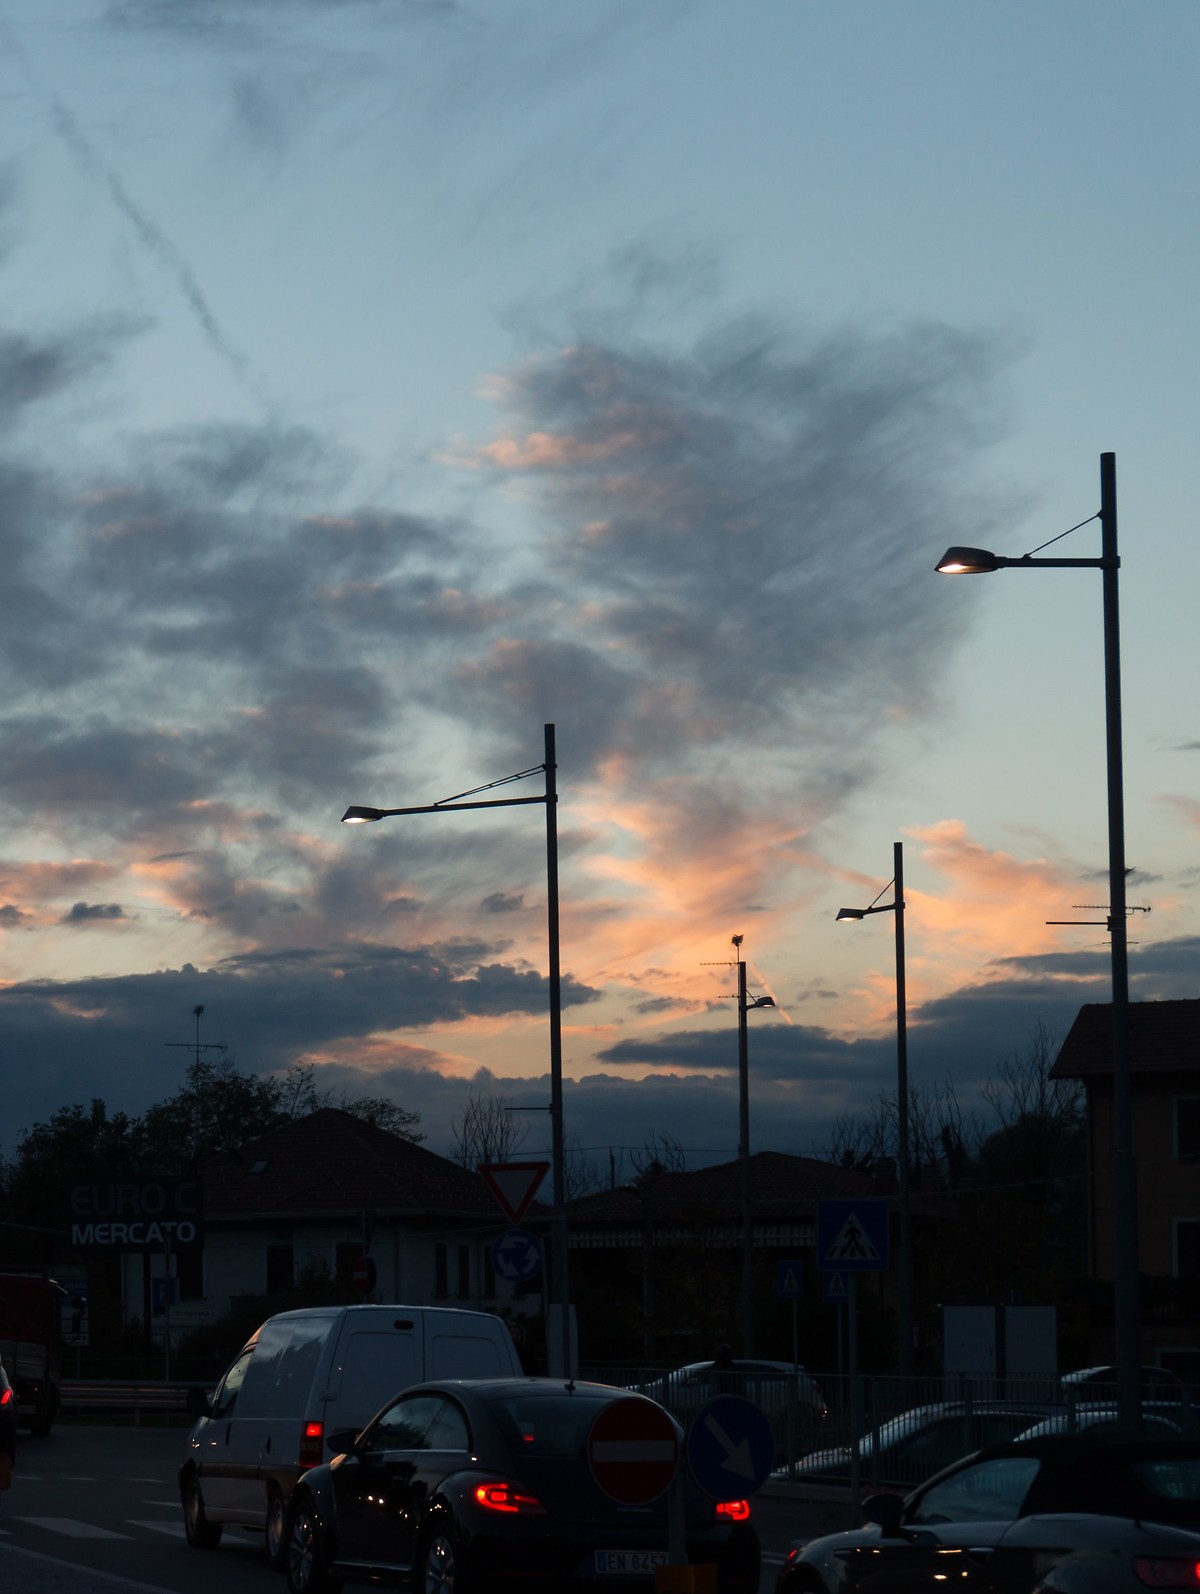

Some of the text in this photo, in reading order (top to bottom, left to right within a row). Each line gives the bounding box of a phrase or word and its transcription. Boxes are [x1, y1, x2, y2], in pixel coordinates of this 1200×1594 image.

[70, 1182, 197, 1215] EURO C
[71, 1220, 196, 1245] MERCATO
[608, 1554, 626, 1570] EN
